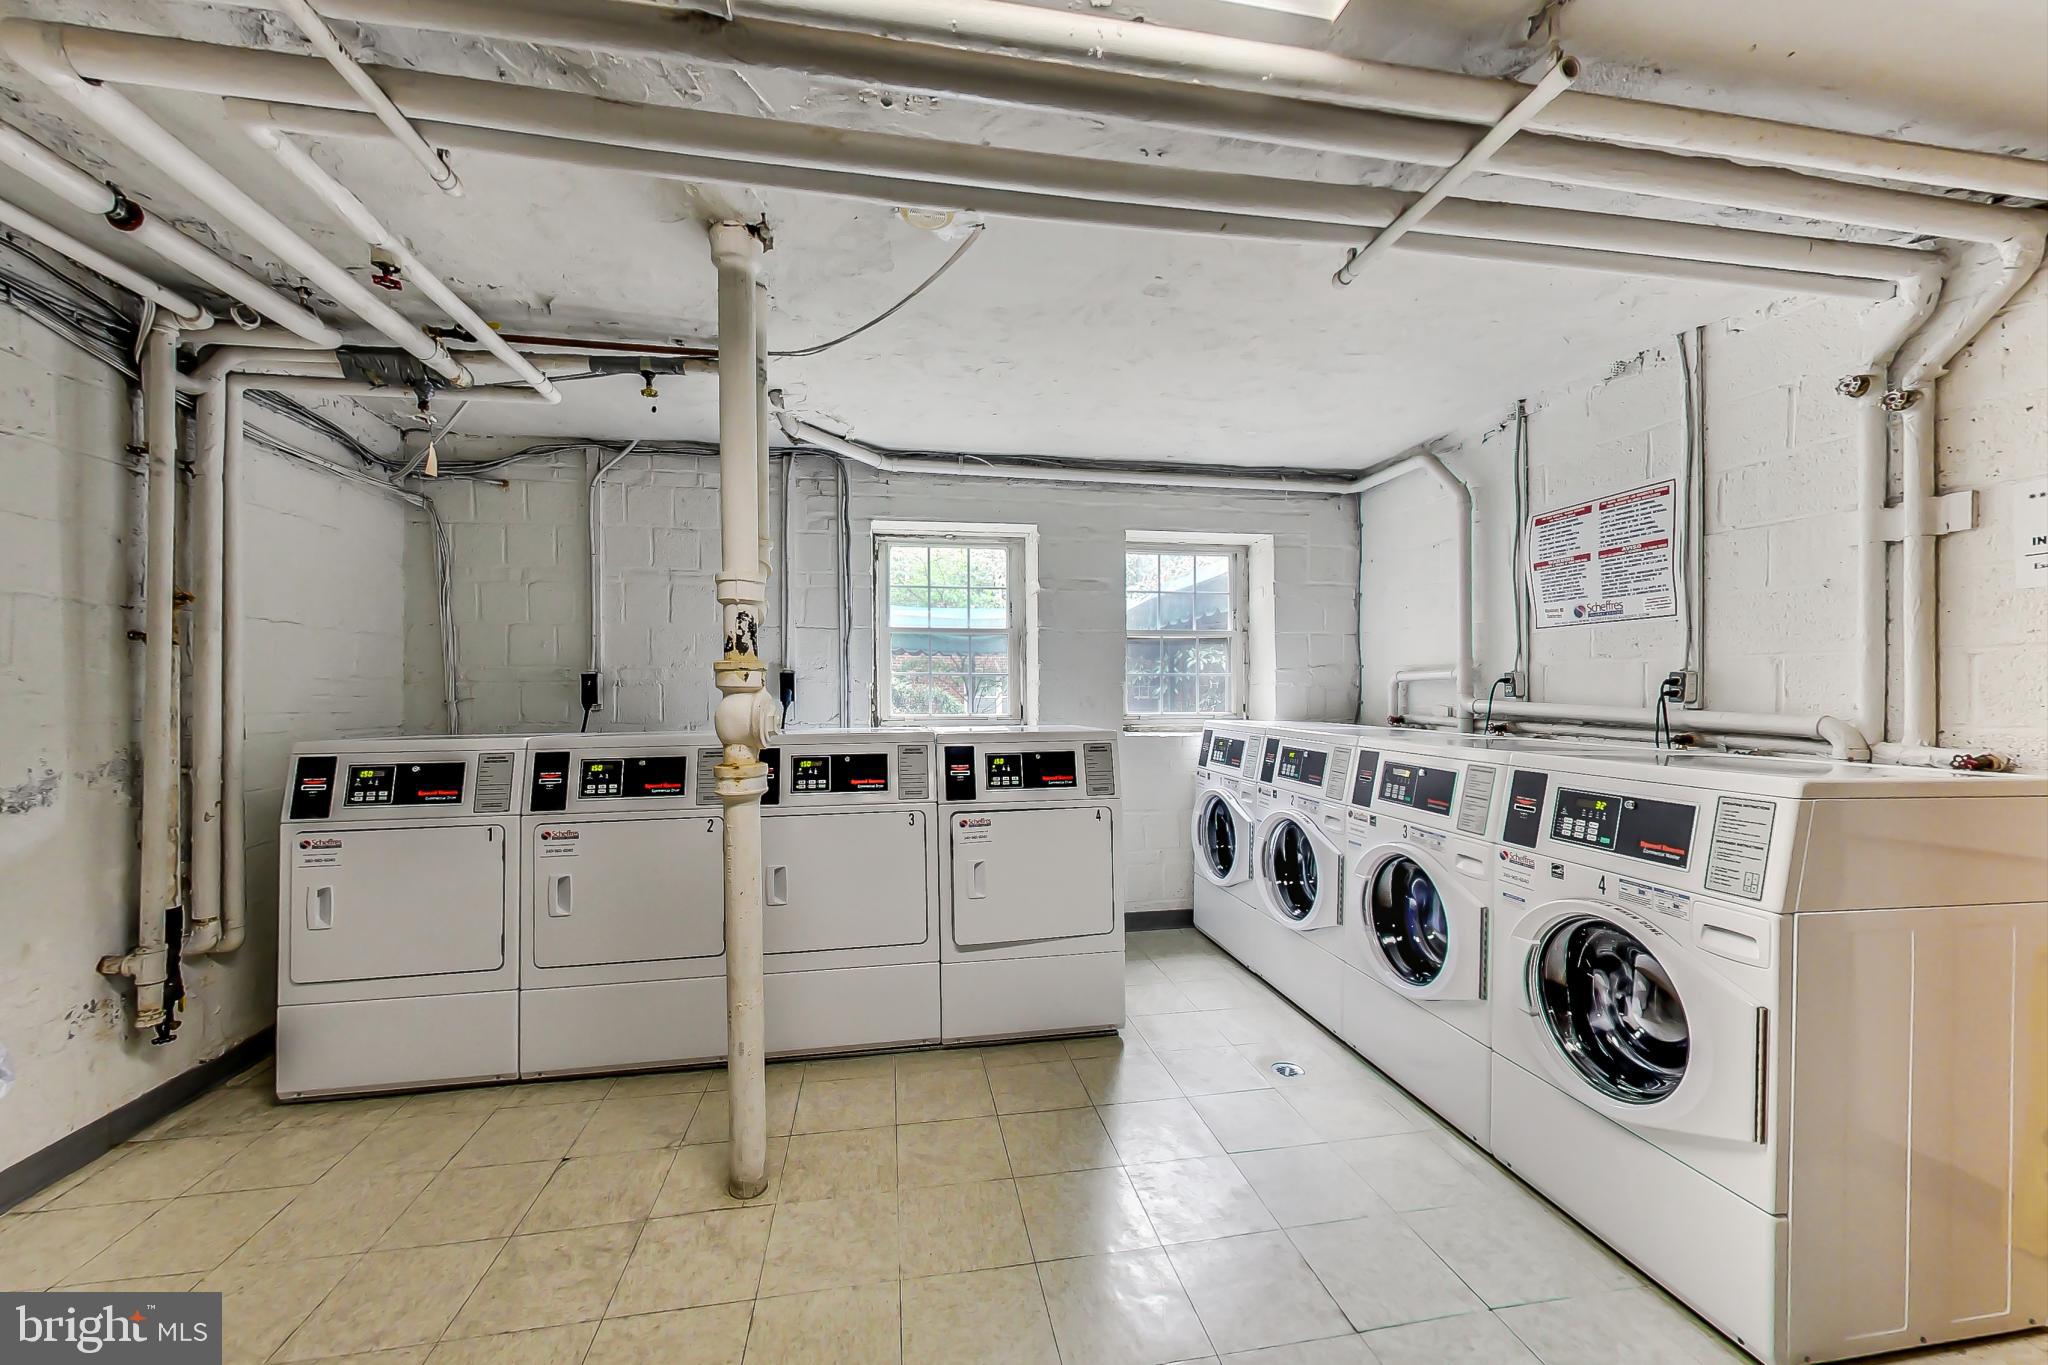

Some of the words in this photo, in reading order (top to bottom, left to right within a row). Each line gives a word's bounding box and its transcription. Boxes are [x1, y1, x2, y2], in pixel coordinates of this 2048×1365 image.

[1587, 599, 1624, 613] Scheffres
[1290, 794, 1295, 807] 2
[908, 813, 915, 826] 3
[1095, 809, 1102, 822] 4
[706, 819, 714, 833] 2
[1402, 824, 1408, 839] 3
[487, 827, 493, 842] 1
[1509, 850, 1535, 866] Scheffres
[1598, 874, 1606, 896] 4
